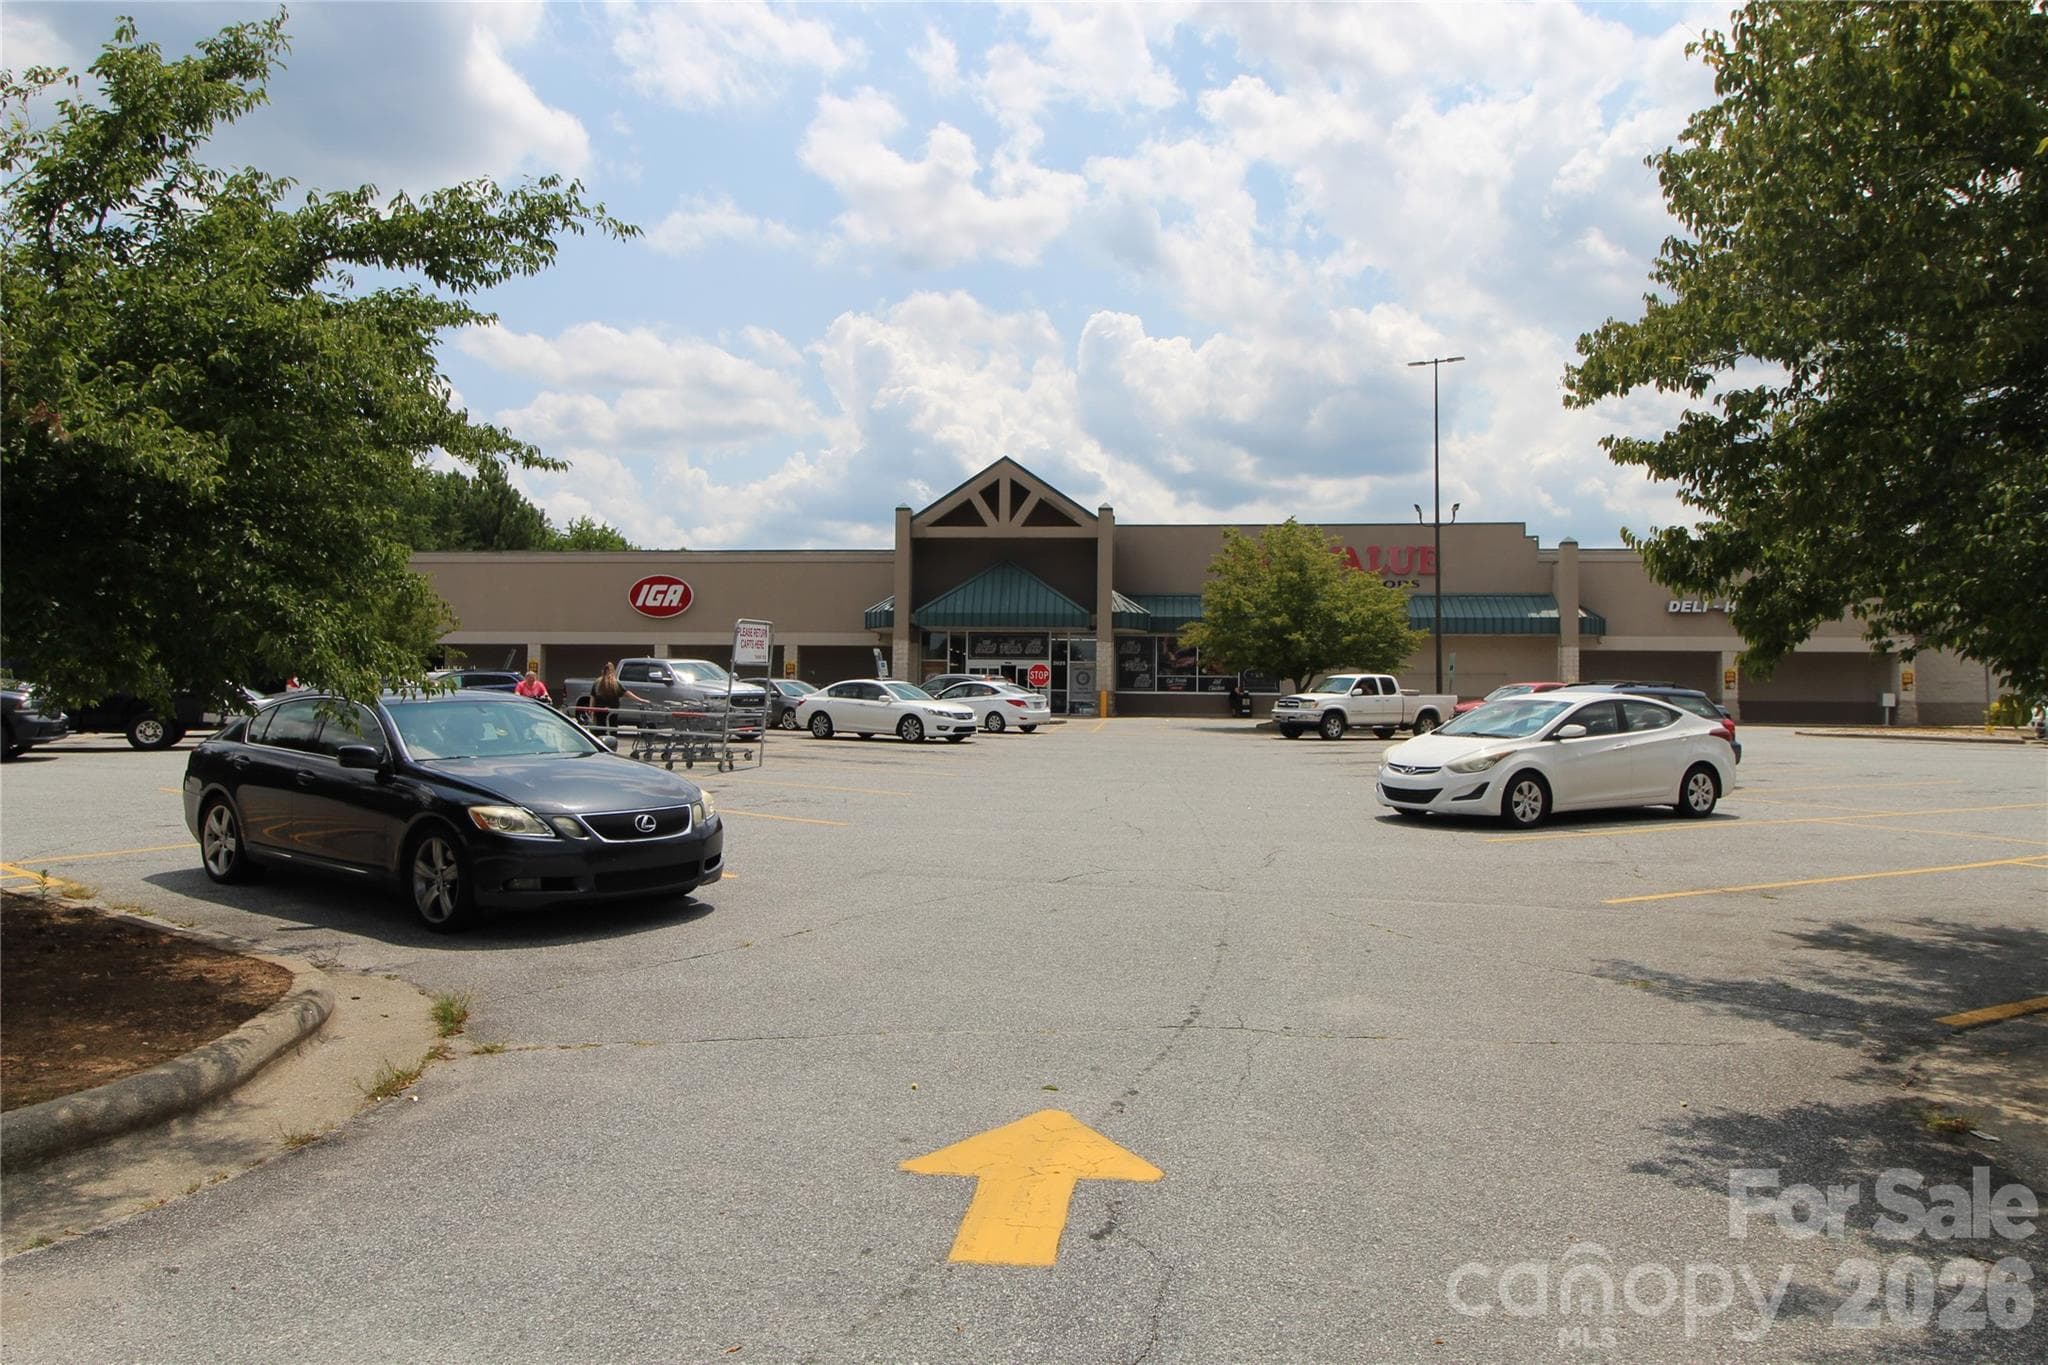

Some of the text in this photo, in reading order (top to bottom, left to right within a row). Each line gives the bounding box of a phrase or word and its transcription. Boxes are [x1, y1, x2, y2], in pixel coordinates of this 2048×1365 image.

[1328, 545, 1437, 576] ALUE
[635, 584, 685, 607] IGA
[1668, 600, 1709, 613] DELI
[736, 627, 753, 637] PLEASE
[741, 639, 765, 649] CARTS HERE
[1030, 670, 1049, 680] STOP
